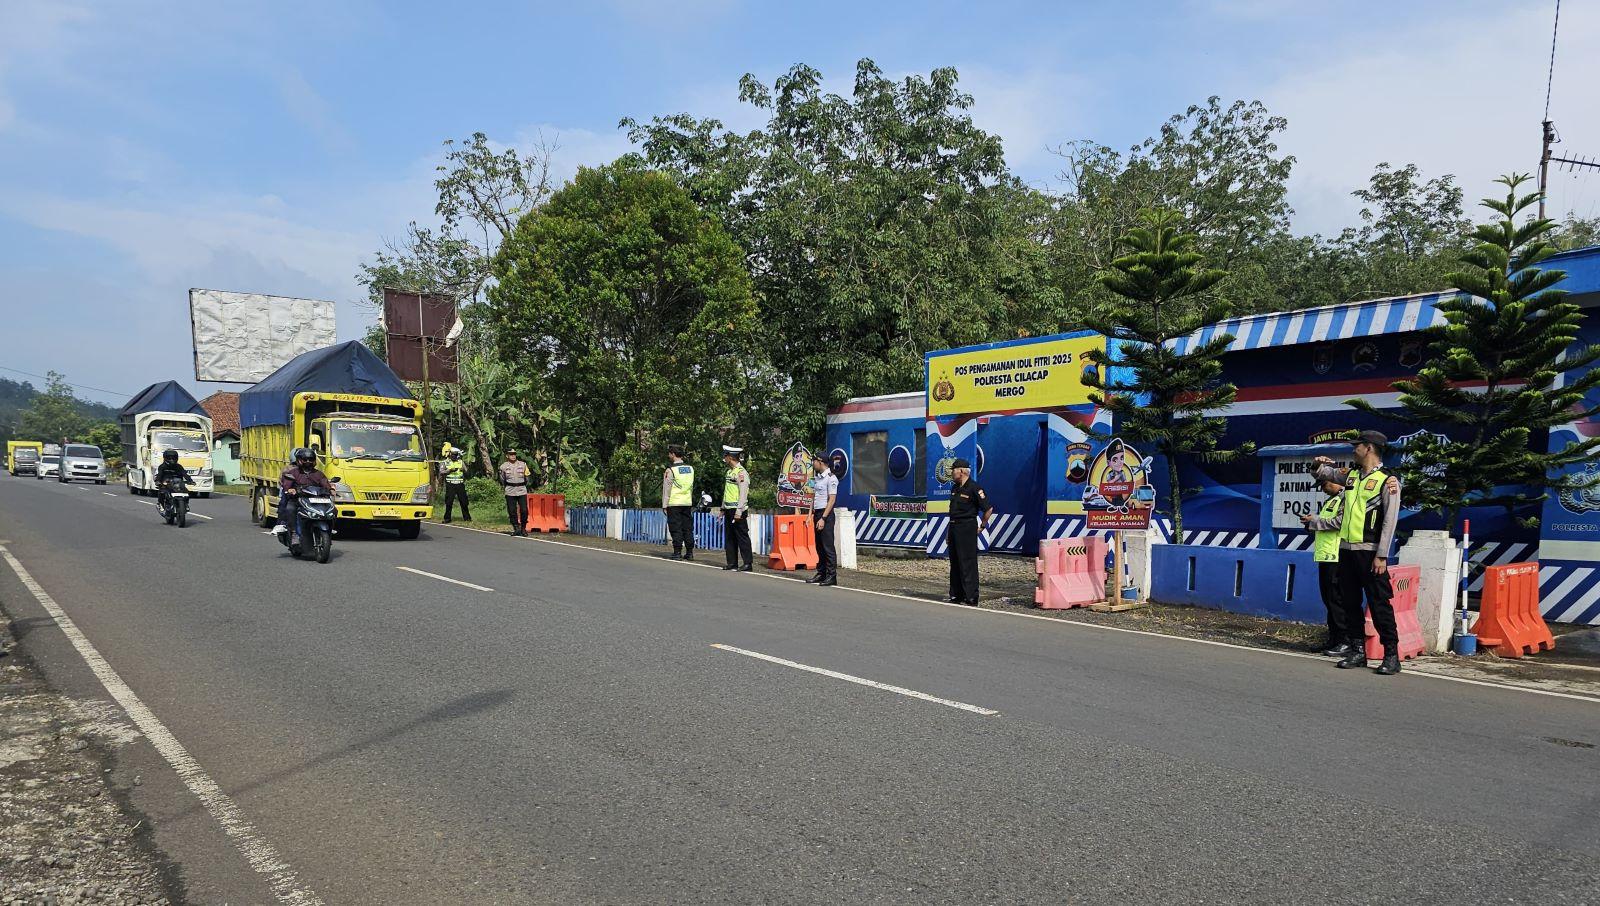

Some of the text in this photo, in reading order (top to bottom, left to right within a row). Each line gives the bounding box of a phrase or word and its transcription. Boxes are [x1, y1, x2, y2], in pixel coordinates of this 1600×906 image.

[955, 366, 967, 376] POS
[969, 360, 1016, 374] PENGAMANAN
[1017, 359, 1032, 369] IDUL
[1034, 356, 1051, 367] FITRI
[1052, 353, 1072, 365] 2025
[974, 370, 1049, 386] POLRESTA CILACAP
[995, 386, 1025, 397] MERGO
[1313, 432, 1332, 444] JAWA
[1278, 462, 1312, 474] POLRES
[1279, 482, 1311, 492] SATUAN
[875, 501, 927, 512] POS KESEHATAN
[1552, 523, 1598, 532] POLRESTA
